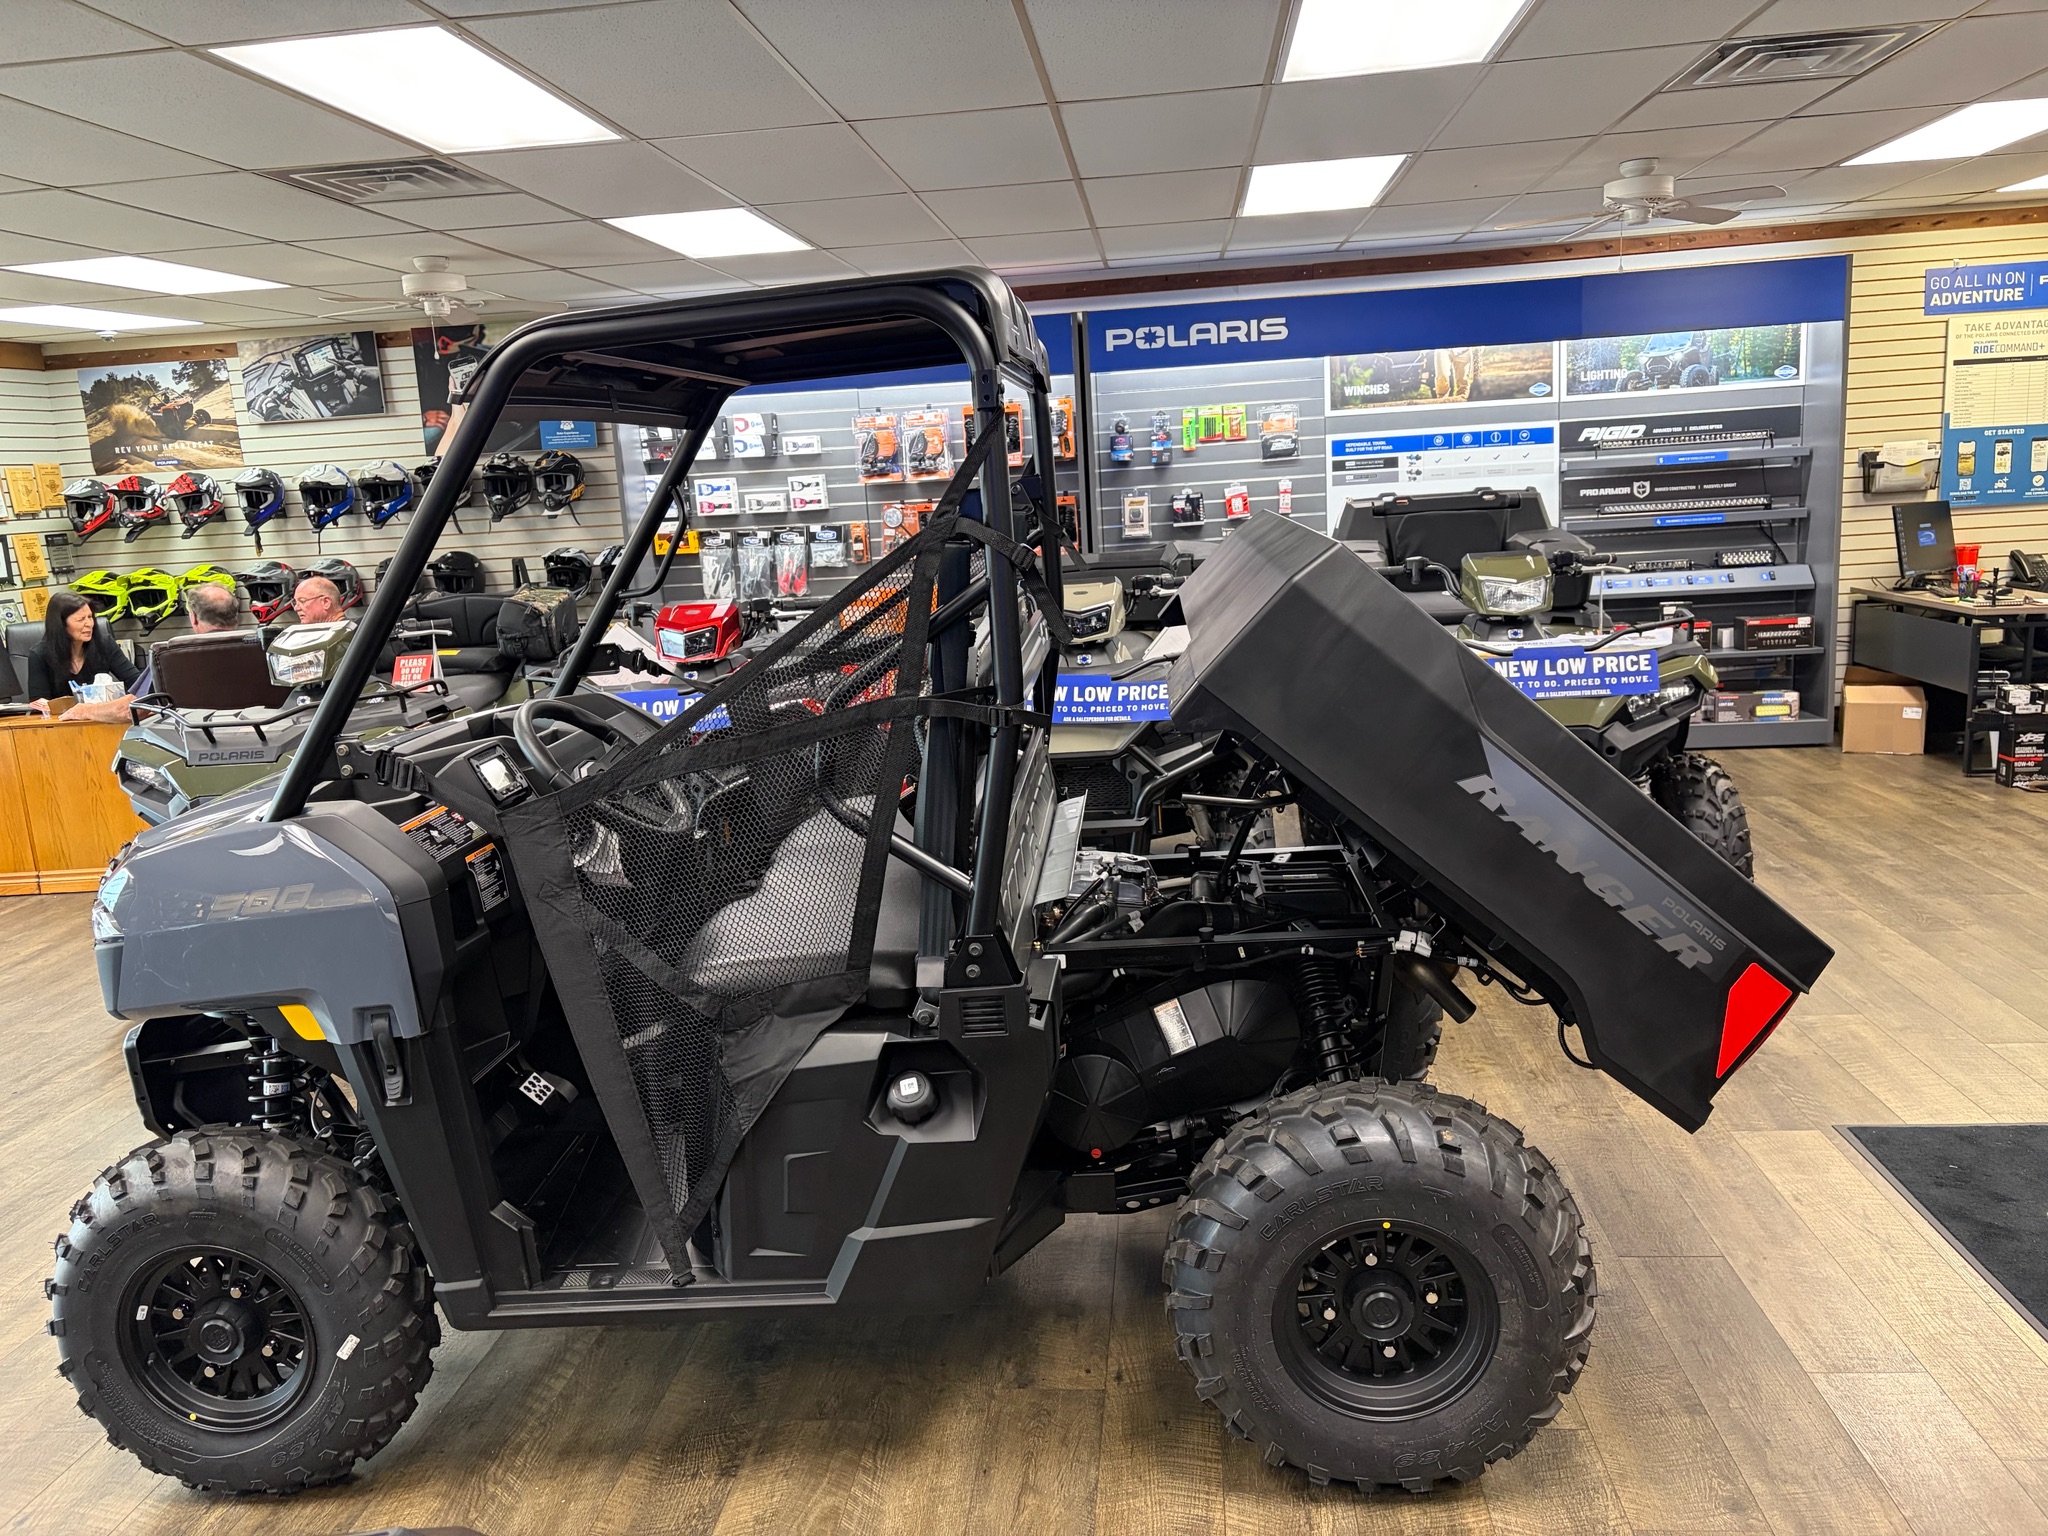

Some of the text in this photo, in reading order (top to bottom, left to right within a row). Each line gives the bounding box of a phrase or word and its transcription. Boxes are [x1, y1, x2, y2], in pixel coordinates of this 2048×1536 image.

[1931, 277, 1950, 289] GO
[1954, 274, 1982, 288] ALL
[1987, 273, 2001, 286] IN
[2006, 271, 2025, 284] ON
[1930, 288, 2024, 306] ADVENTURE
[1106, 318, 1288, 351] POLARIS
[1965, 323, 1992, 332] TAKE
[1580, 368, 1628, 382] LIGHTING
[1344, 384, 1390, 396] WINCHES
[1578, 425, 1646, 441] RIGID
[136, 444, 158, 452] YOUR
[163, 440, 214, 451] HEARTBEAT
[1580, 487, 1631, 497] PRO ARMOR
[400, 658, 427, 667] PLEASE
[1495, 654, 1652, 678] NEW LOW PRICE
[1544, 680, 1561, 688] GO.
[1565, 679, 1600, 687] PRICED
[1621, 676, 1653, 684] MOVE.
[1074, 686, 1112, 702] LOW
[1118, 684, 1169, 701] PRICE
[1142, 703, 1168, 711] MOVE.
[2016, 732, 2046, 743] XPS
[198, 751, 265, 761] POLARIS
[1455, 774, 1713, 970] RANGER
[1661, 896, 1727, 952] POLARIS
[1260, 1176, 1384, 1241] CARLSTAR
[78, 1213, 160, 1294] CARLSTAR
